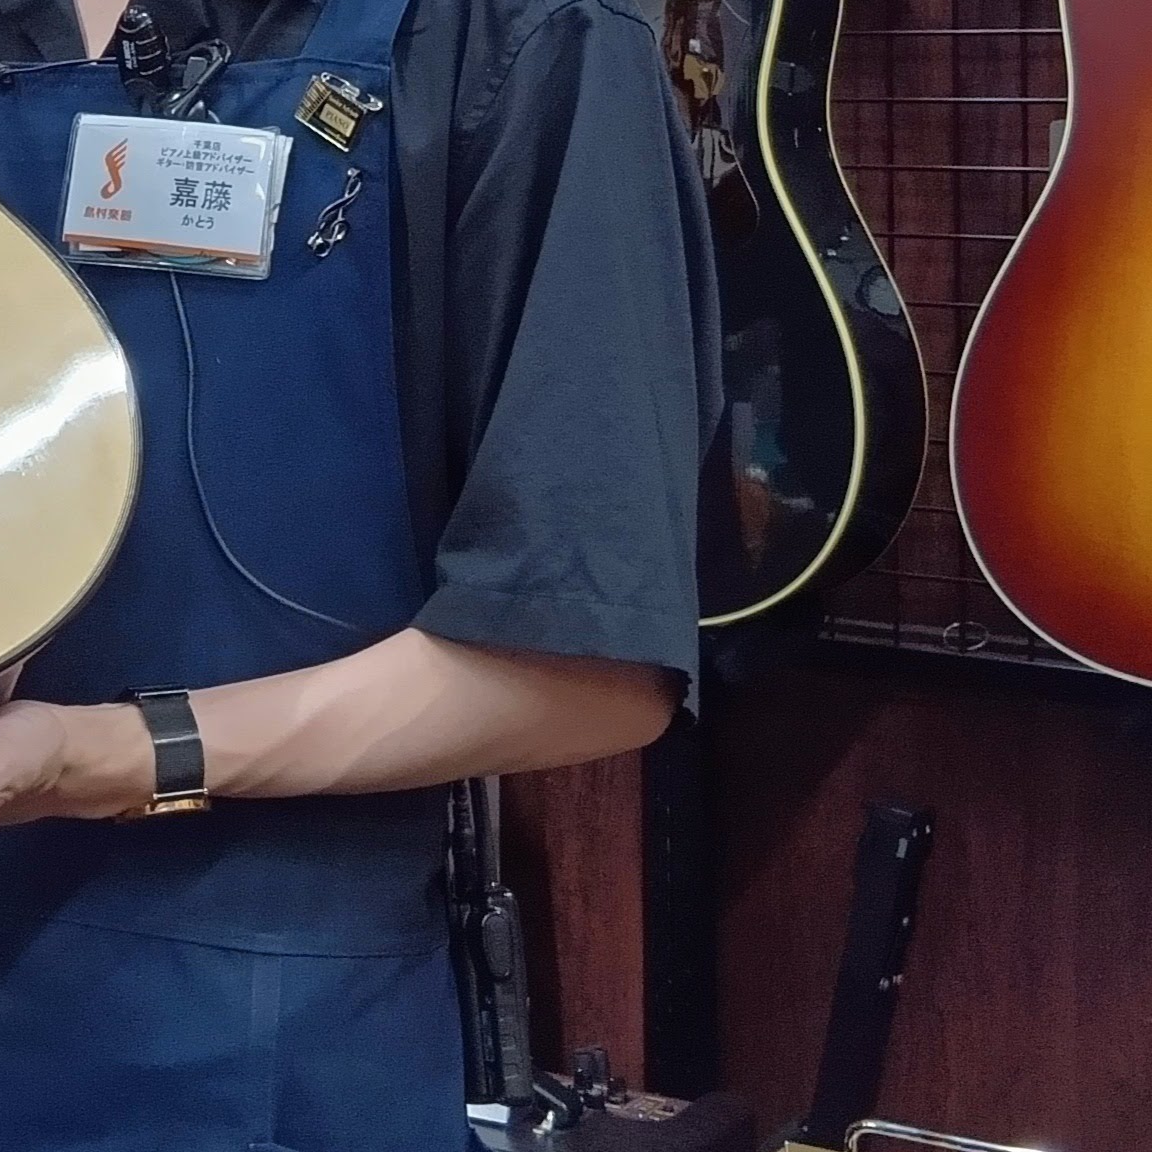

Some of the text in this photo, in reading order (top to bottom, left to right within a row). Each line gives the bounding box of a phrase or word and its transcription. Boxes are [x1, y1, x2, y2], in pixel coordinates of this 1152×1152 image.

[193, 140, 221, 150] 千葉店
[169, 177, 233, 212] 嘉藤
[83, 206, 132, 222] 島村楽器
[181, 215, 215, 230] かとう
